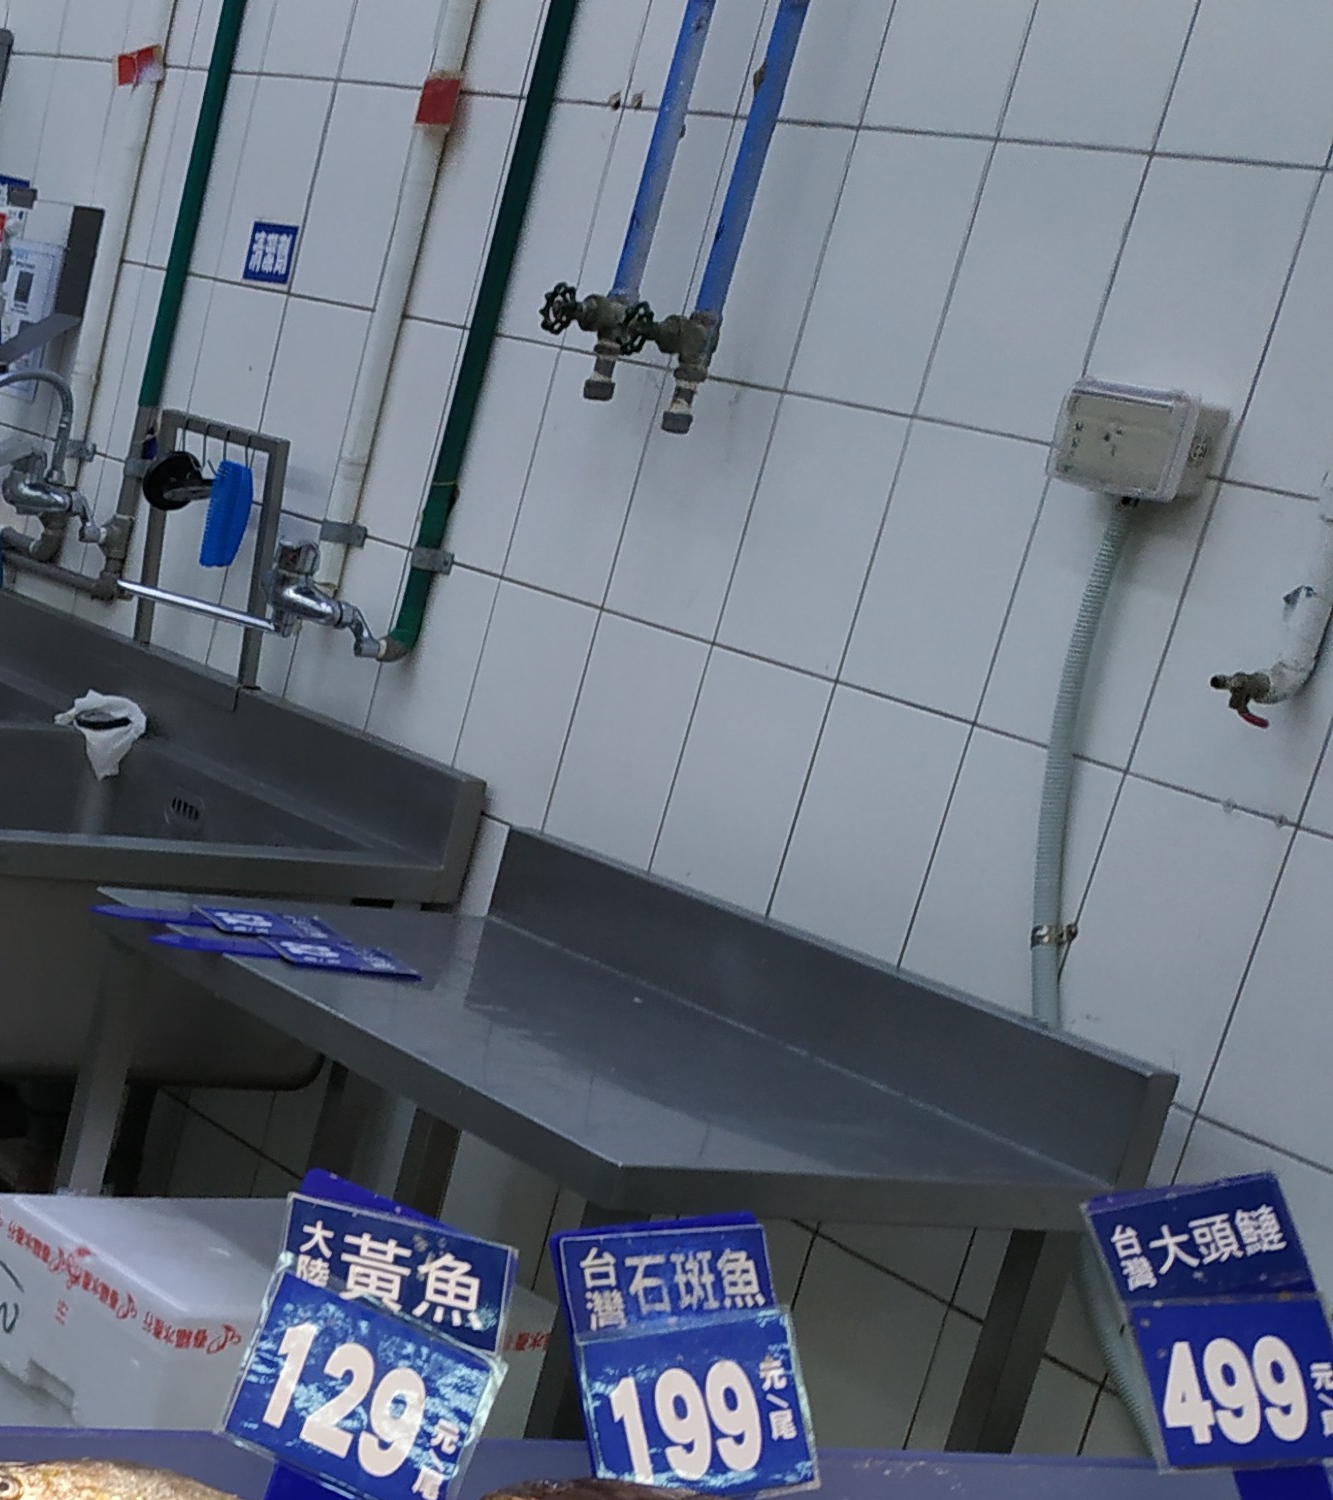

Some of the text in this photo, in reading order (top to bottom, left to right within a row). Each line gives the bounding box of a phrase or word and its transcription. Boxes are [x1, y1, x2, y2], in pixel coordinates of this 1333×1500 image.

[295, 1220, 334, 1287] 大陸
[580, 1247, 766, 1331] 台灣 石斑魚
[1111, 1224, 1157, 1292] 台灣
[263, 1321, 426, 1477] 129
[610, 1360, 762, 1485] 199
[1163, 1335, 1308, 1444] 499
